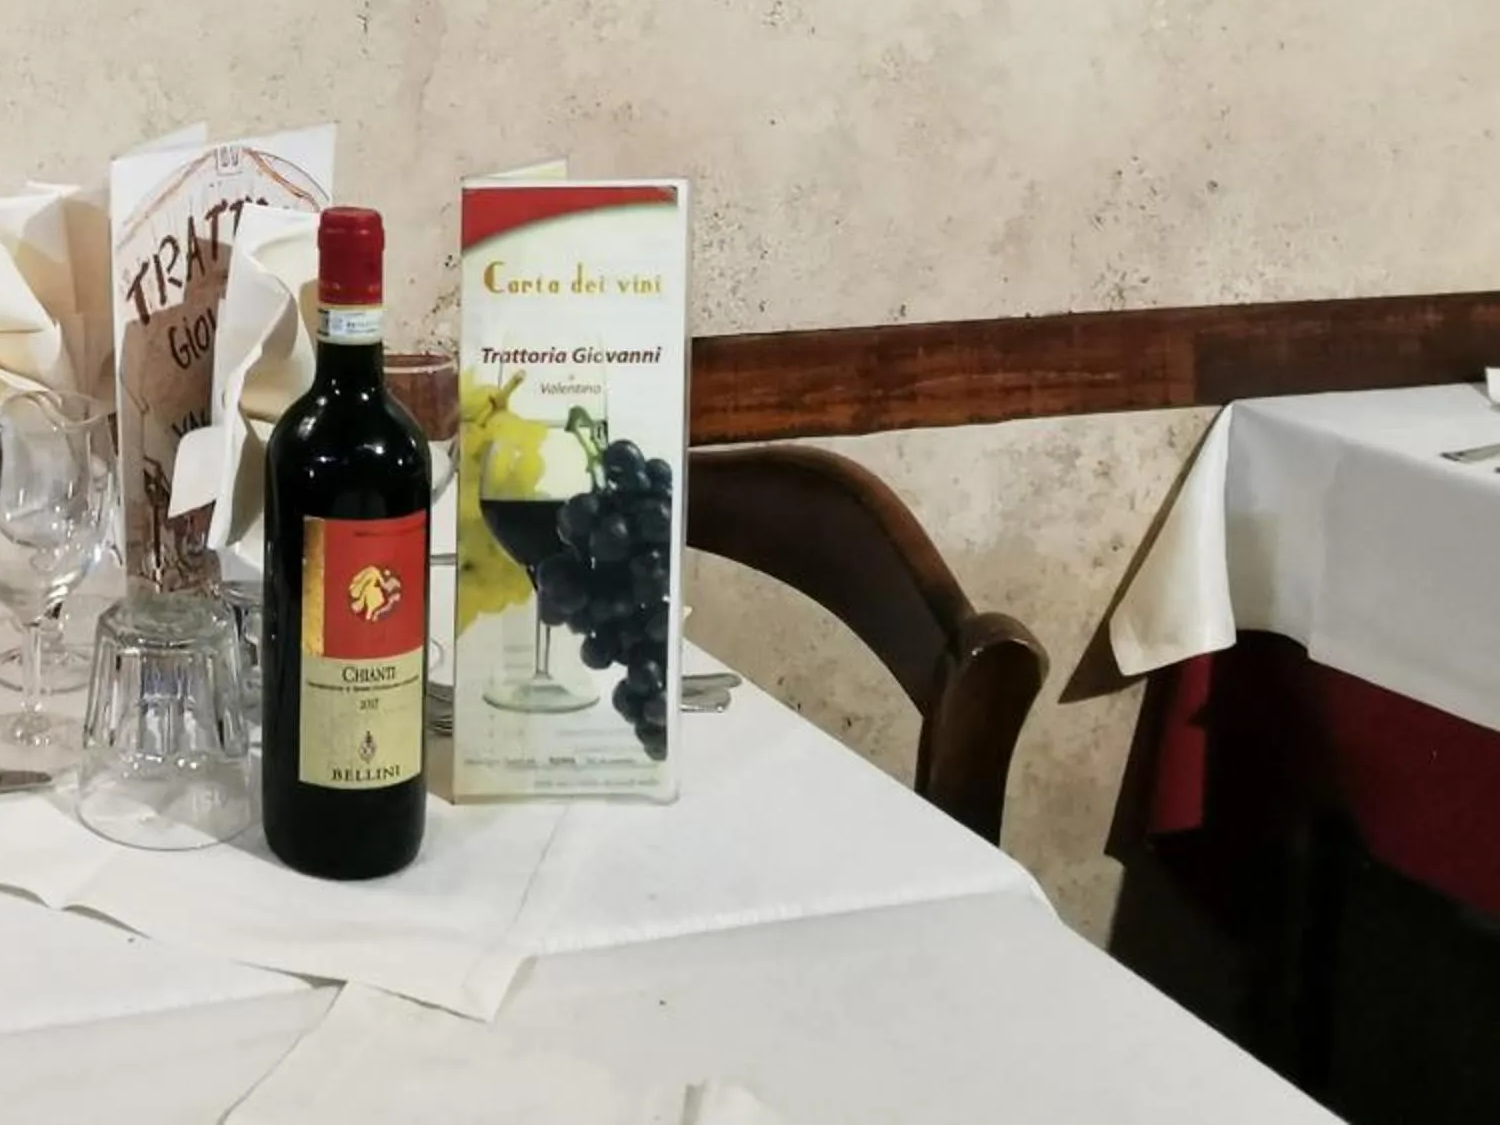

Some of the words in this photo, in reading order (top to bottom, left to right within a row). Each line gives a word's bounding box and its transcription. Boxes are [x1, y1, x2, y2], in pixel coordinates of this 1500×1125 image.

[126, 194, 269, 325] TRATT
[483, 261, 560, 295] Carta
[571, 262, 605, 295] dei
[617, 274, 663, 295] vini
[480, 346, 568, 365] Trattoria
[572, 345, 663, 365] Giovanni
[539, 381, 602, 396] Valentino
[331, 764, 402, 782] BELLINI
